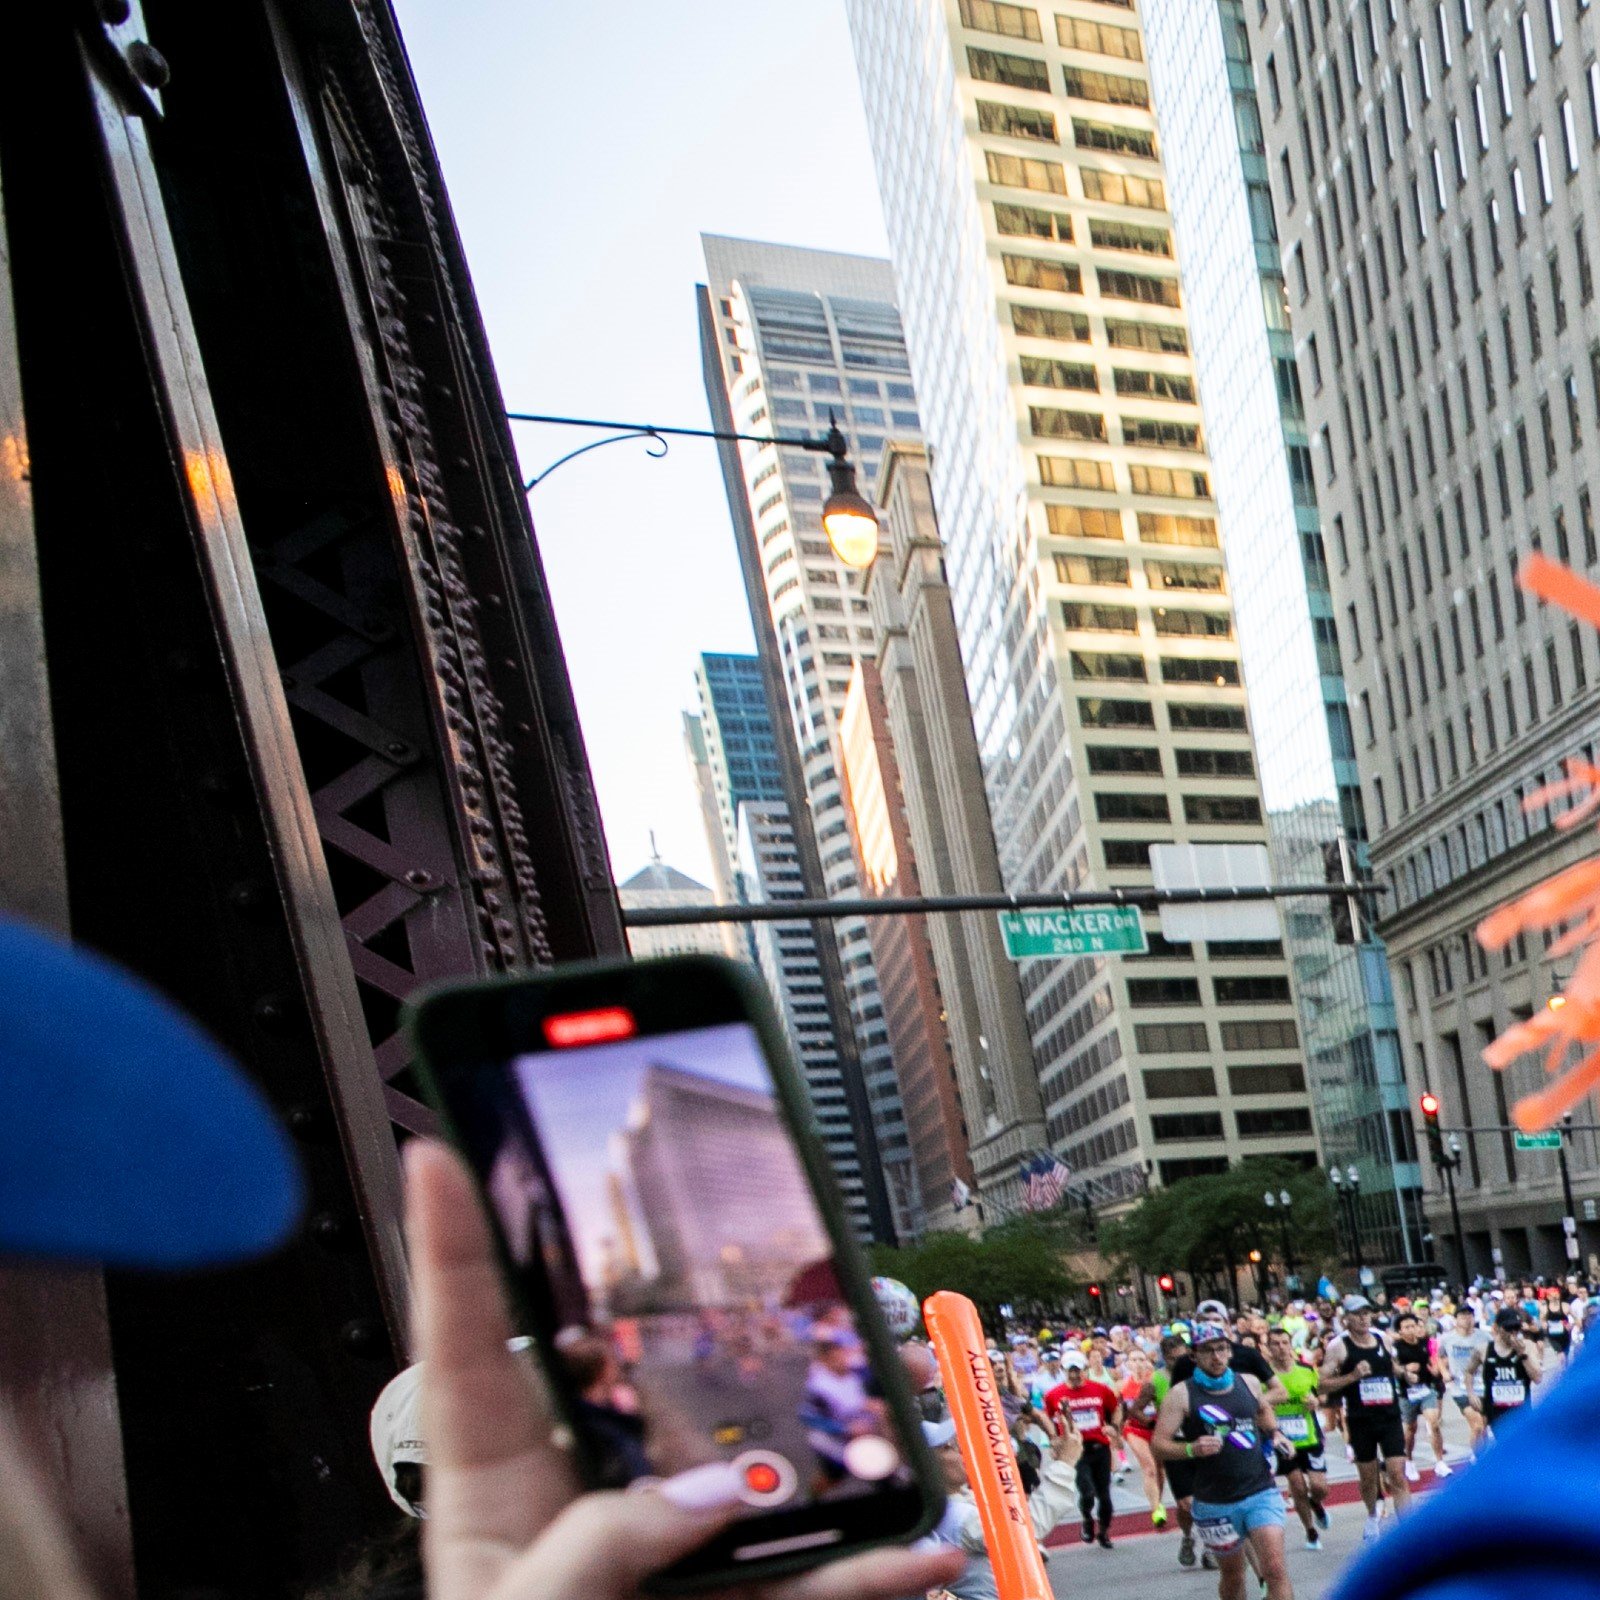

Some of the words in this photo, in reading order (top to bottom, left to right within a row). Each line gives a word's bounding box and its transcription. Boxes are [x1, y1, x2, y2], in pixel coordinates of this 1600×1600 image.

[1007, 920, 1021, 933] W
[1023, 913, 1112, 936] WACKER
[1113, 914, 1135, 928] DR
[1053, 937, 1083, 952] 240
[1091, 937, 1104, 951] N
[967, 1350, 990, 1392] CITY
[1494, 1367, 1517, 1380] JIN
[979, 1397, 1001, 1447] YORK
[993, 1452, 1018, 1494] NEW
